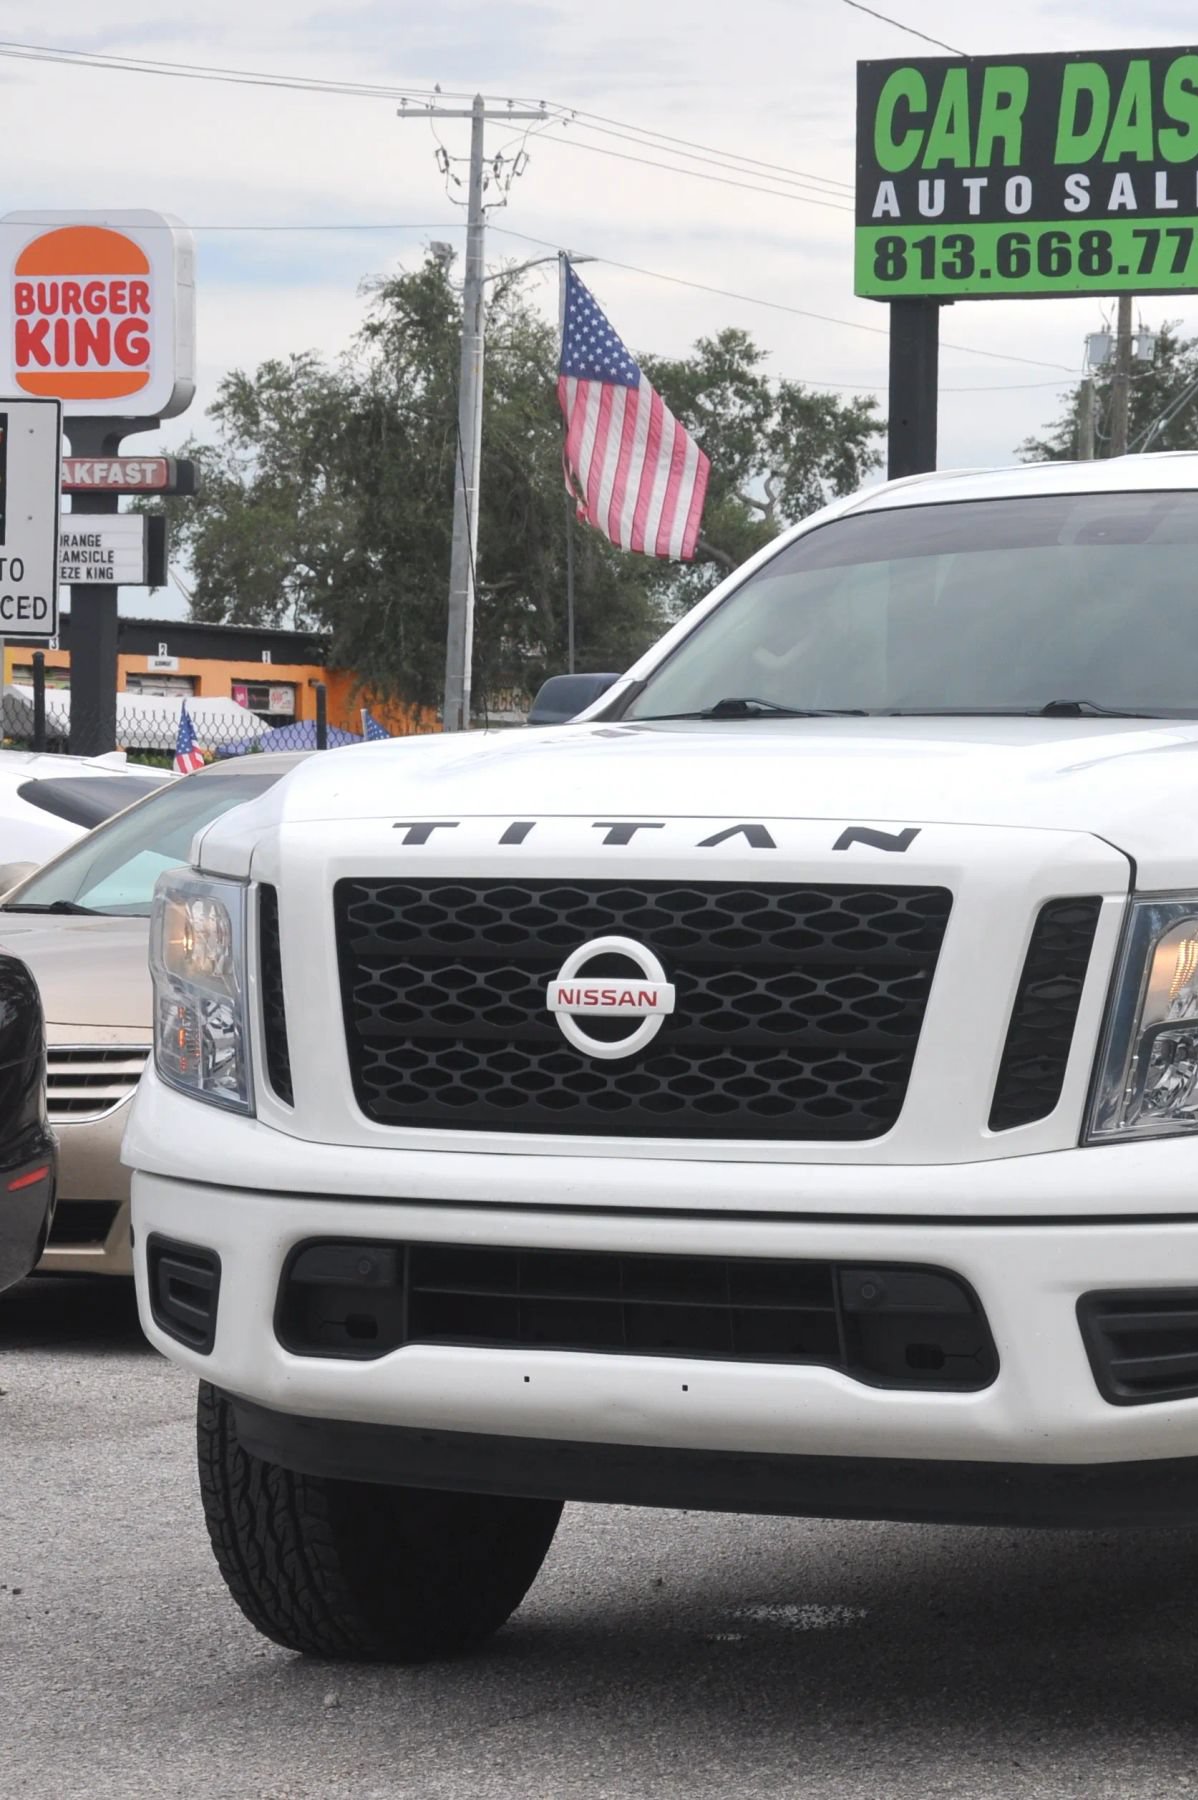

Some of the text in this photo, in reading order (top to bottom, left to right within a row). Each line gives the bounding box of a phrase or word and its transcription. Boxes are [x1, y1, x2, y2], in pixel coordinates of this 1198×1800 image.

[874, 65, 1029, 172] CAR
[872, 175, 1032, 218] AUTO
[15, 281, 150, 315] BURGER
[15, 317, 150, 367] KING
[62, 462, 157, 484] AKFAST
[61, 566, 114, 580] EZE KING
[0, 595, 47, 619] CED
[392, 822, 921, 852] TITAN
[558, 988, 657, 1007] NISSAN
